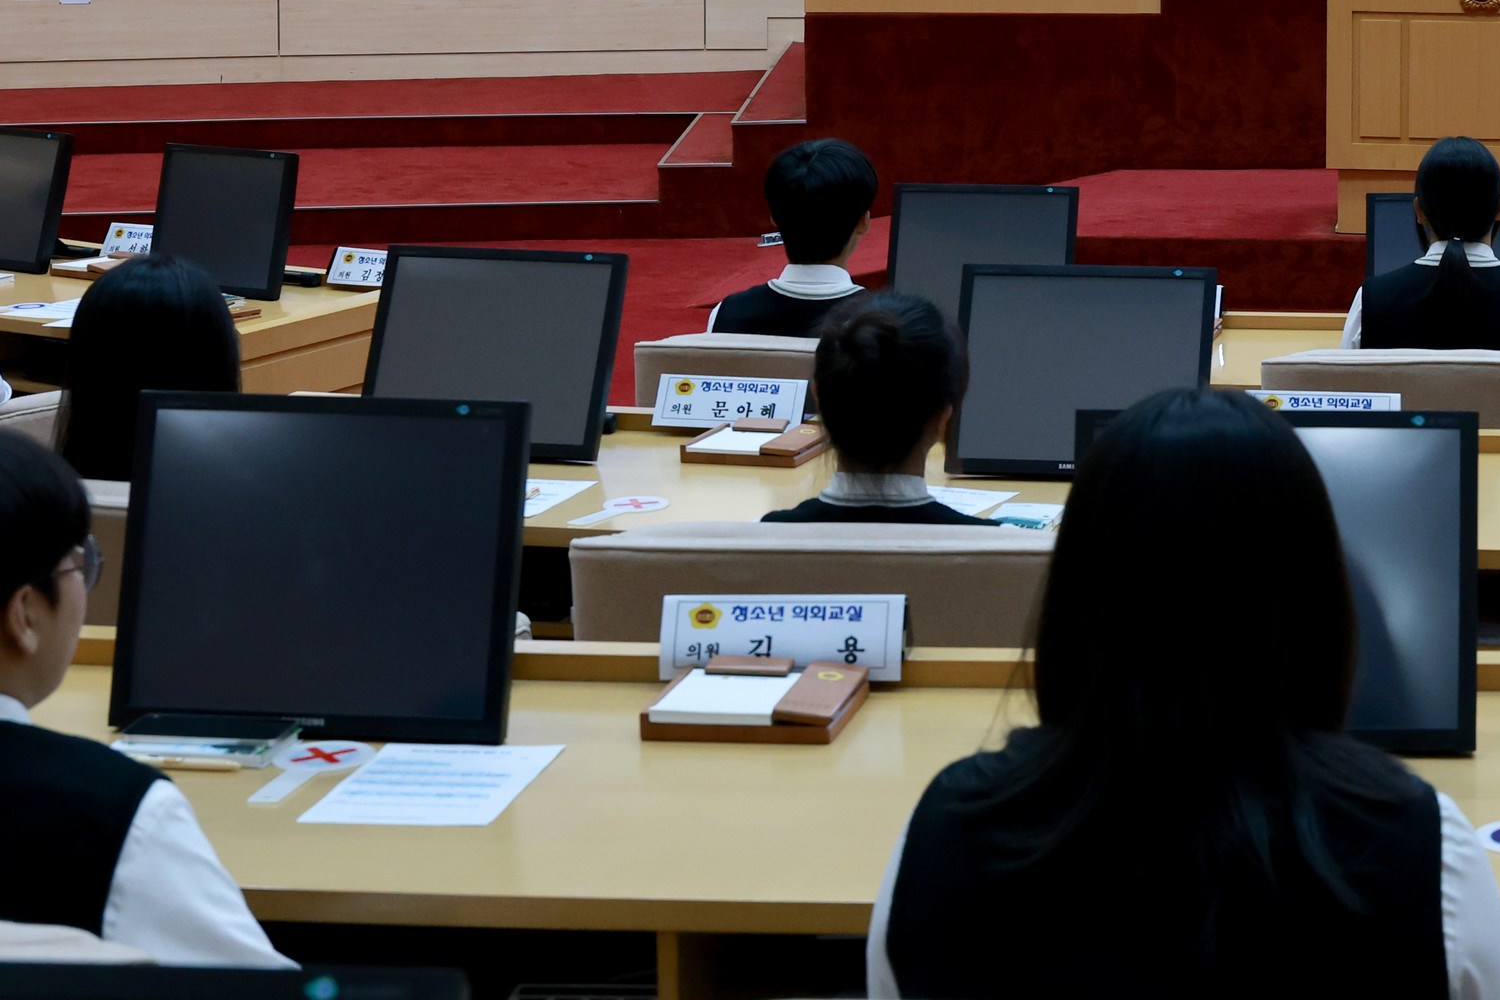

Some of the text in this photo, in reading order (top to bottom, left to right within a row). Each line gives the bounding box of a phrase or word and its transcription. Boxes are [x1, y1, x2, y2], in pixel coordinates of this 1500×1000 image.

[700, 380, 733, 393] 청소년
[1288, 396, 1323, 408] 청소년
[670, 403, 692, 415] 의원
[731, 605, 785, 622] 청소년
